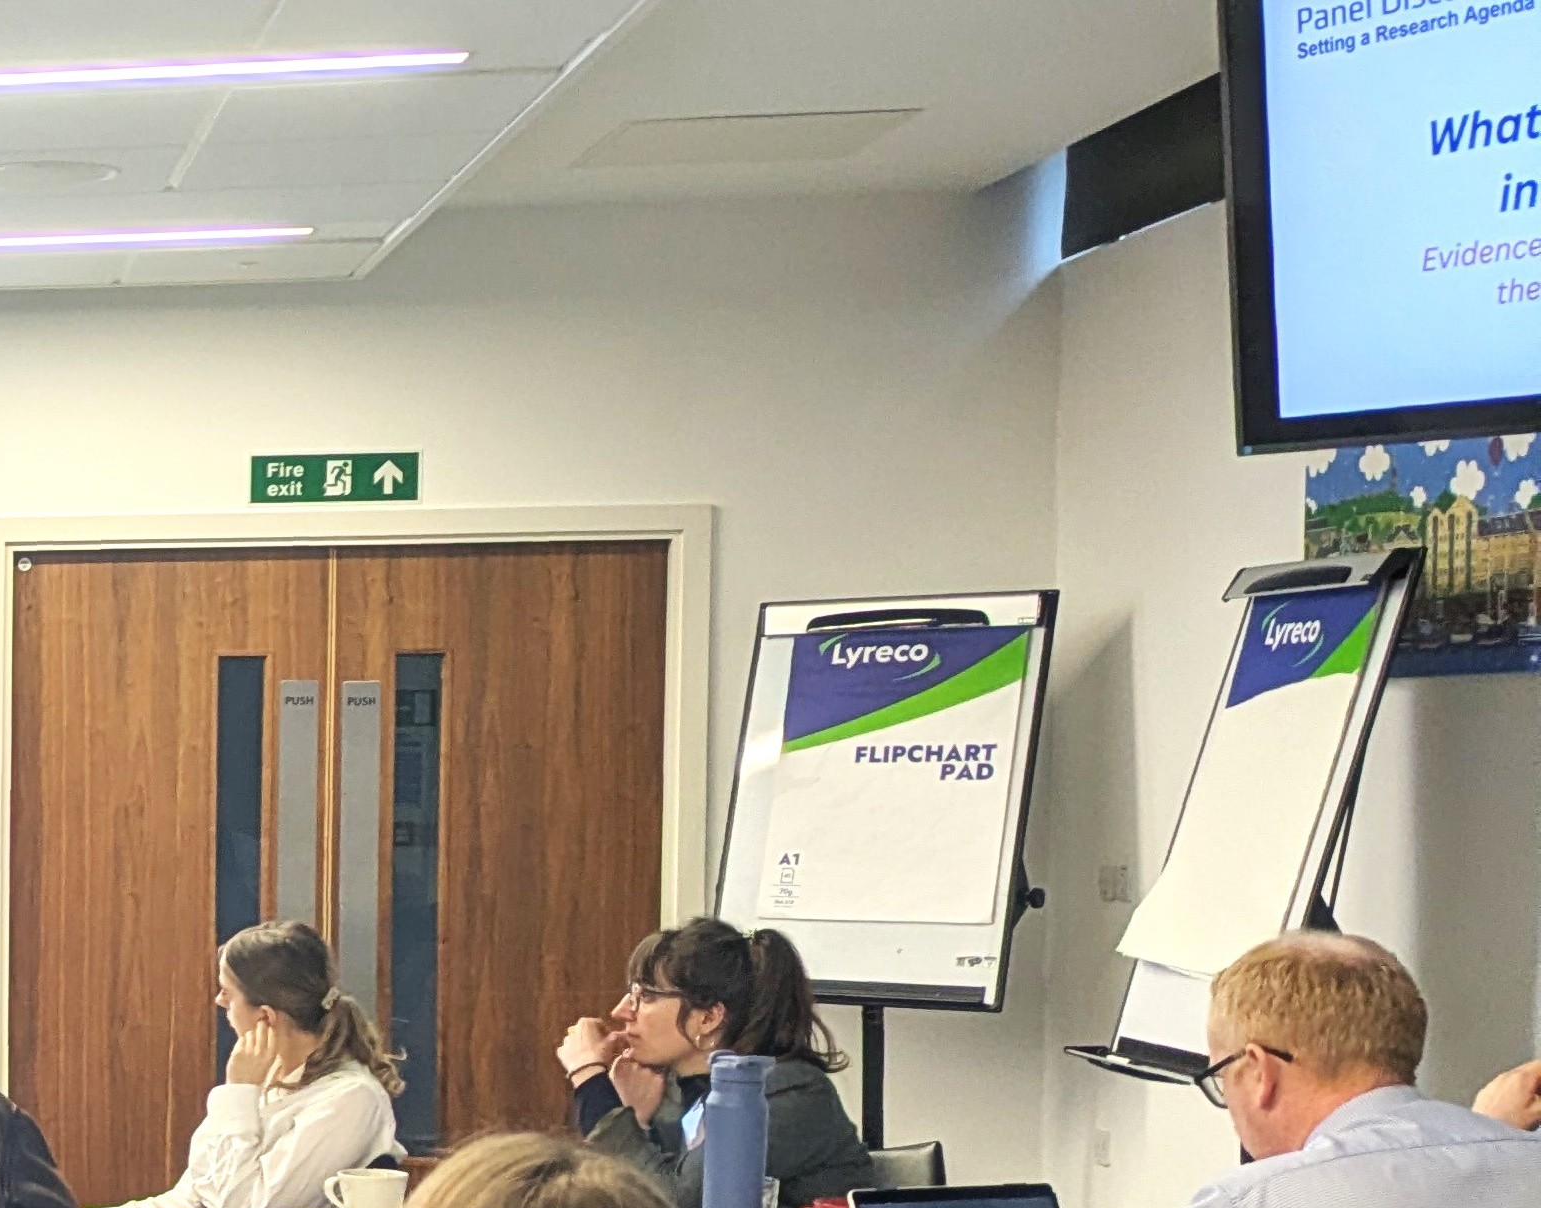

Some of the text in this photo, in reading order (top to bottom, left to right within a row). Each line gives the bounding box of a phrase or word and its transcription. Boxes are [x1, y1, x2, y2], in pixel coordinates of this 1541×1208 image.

[1296, 0, 1372, 34] Panel
[1297, 36, 1356, 59] Setting
[1360, 32, 1370, 46] a
[1375, 11, 1459, 43] Research
[1463, 0, 1536, 25] Agenda
[1430, 104, 1541, 155] What
[1422, 238, 1541, 271] Evidence
[1497, 278, 1540, 304] the
[266, 462, 305, 478] Fire
[266, 481, 304, 497] exit
[1264, 617, 1321, 652] Lyreco
[831, 643, 930, 670] Lyreco
[285, 696, 315, 706] PUSH
[347, 696, 376, 707] PUSH
[855, 744, 998, 764] FLIPCHART
[940, 763, 995, 781] PAD
[778, 853, 800, 866] A1
